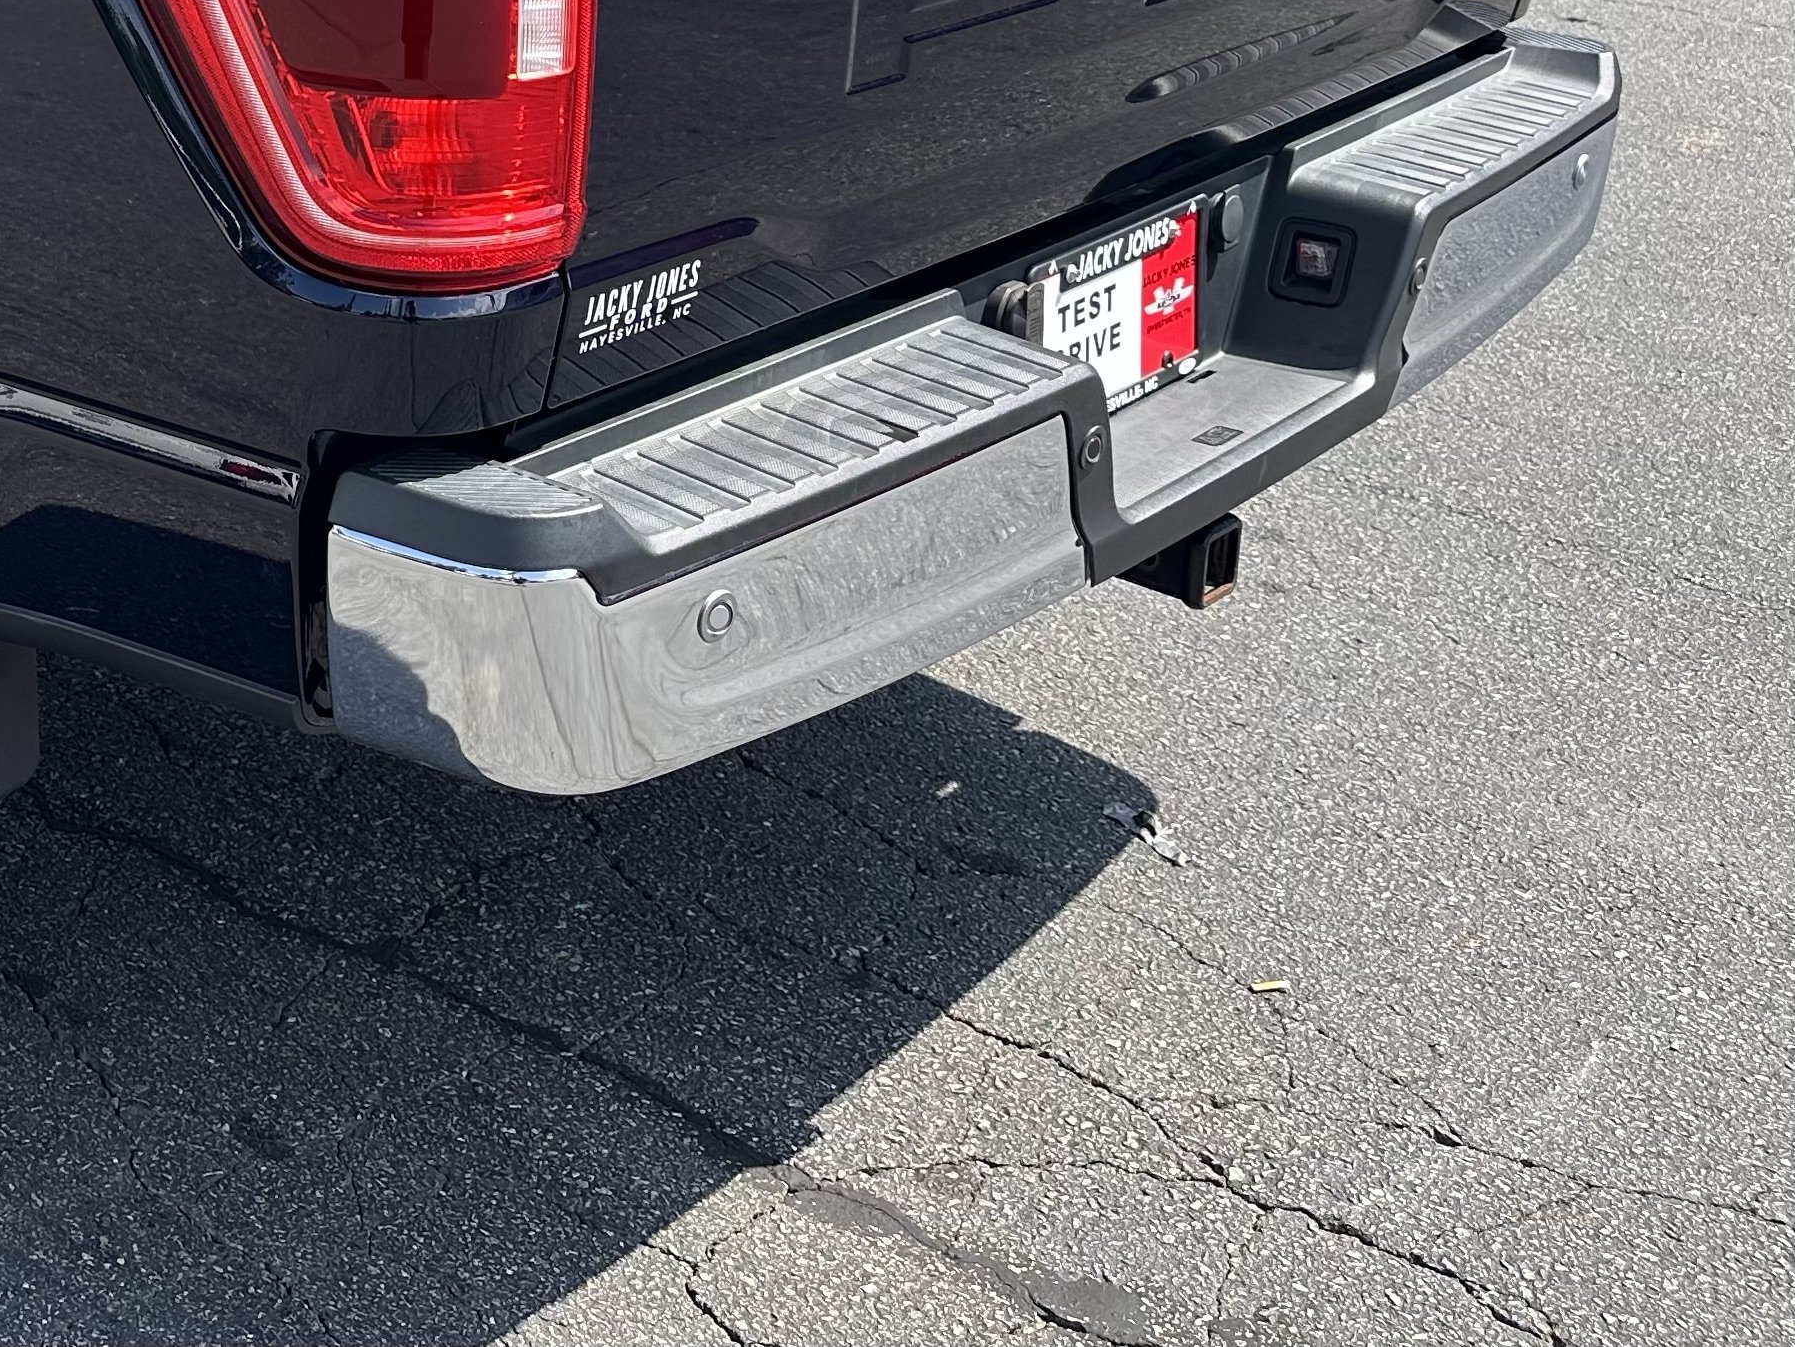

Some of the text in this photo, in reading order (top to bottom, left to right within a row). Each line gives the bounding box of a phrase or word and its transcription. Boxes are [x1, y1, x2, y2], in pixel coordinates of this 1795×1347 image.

[1075, 217, 1170, 282] JACKY JONES
[584, 259, 701, 325] JACKY JONES
[609, 297, 668, 331] FORD
[672, 303, 691, 320] NC
[1057, 283, 1116, 333] TEST
[1058, 322, 1121, 362] RIVE
